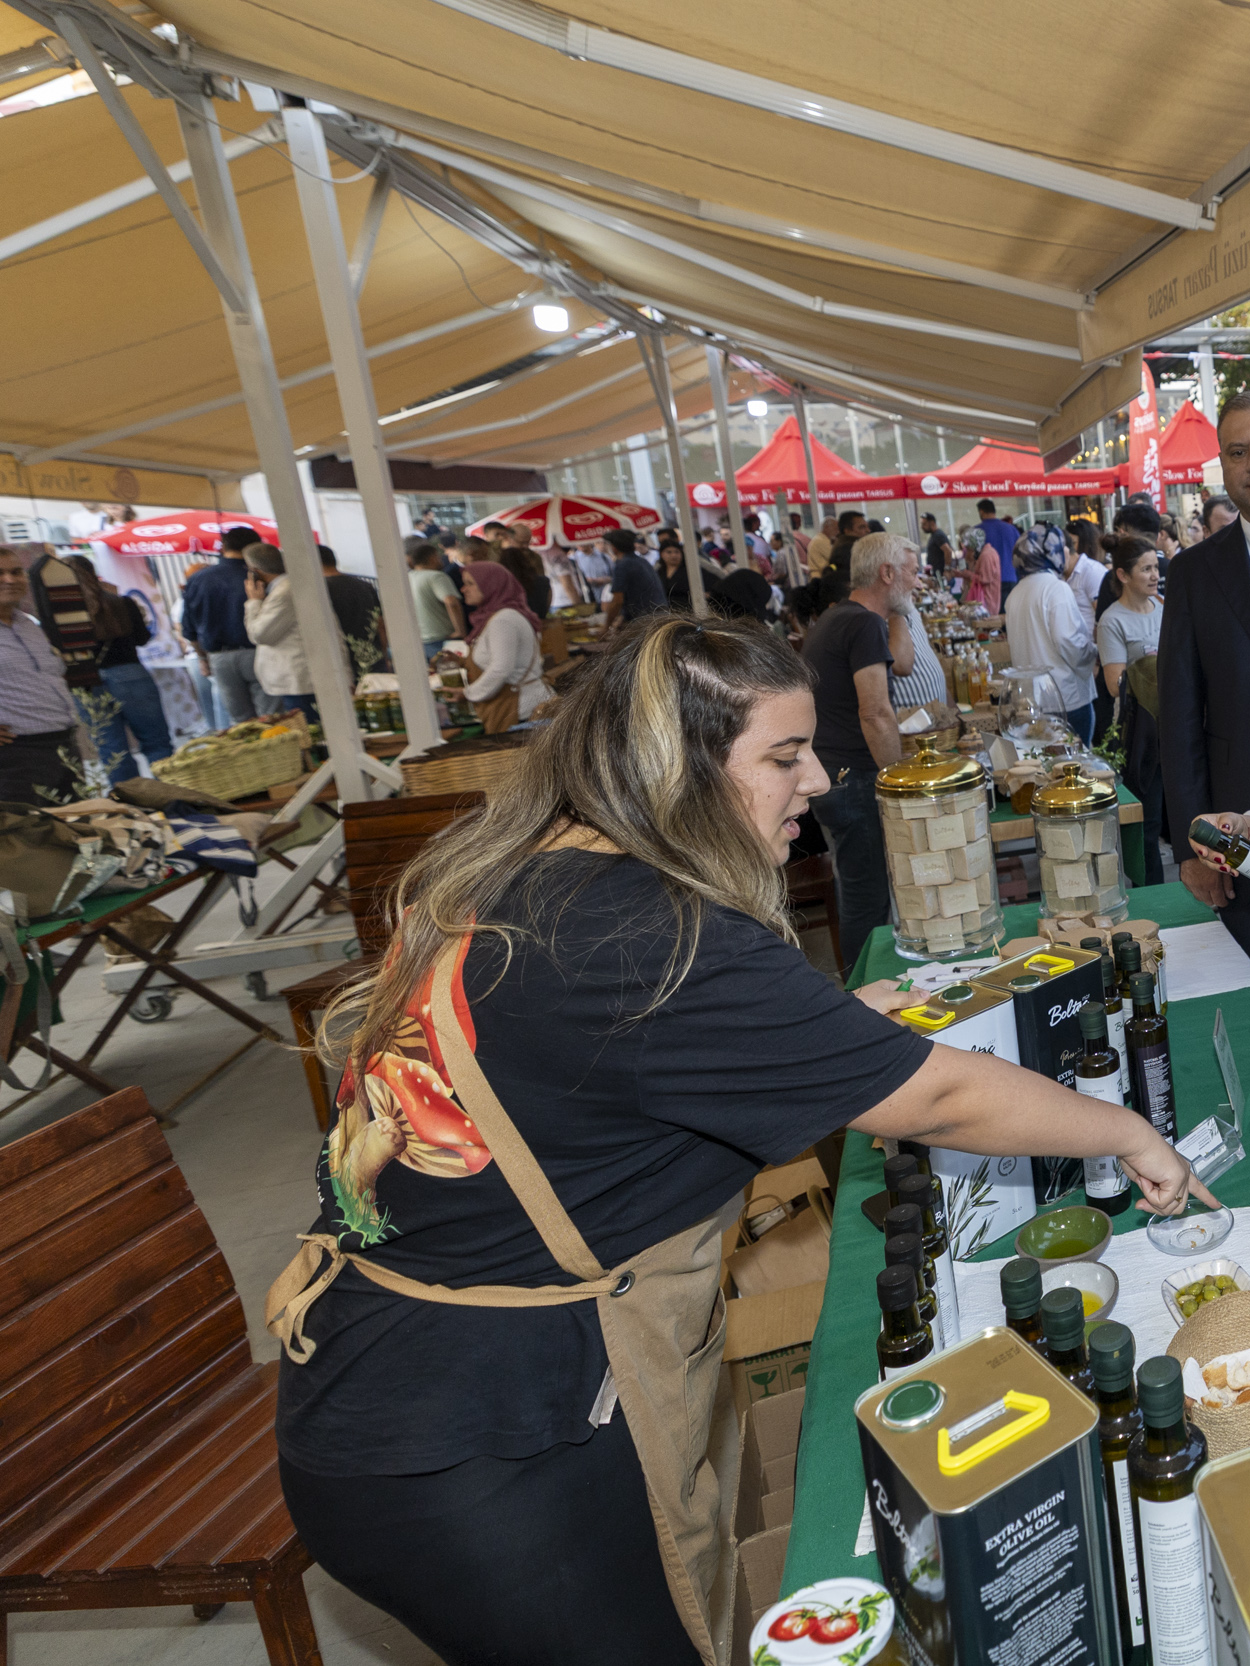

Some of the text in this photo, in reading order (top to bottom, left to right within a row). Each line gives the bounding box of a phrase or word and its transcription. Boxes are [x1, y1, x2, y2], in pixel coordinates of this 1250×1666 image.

[1163, 469, 1186, 480] Slow
[952, 481, 979, 493] Slow
[1013, 482, 1046, 493] Yeryüzü
[1074, 481, 1100, 490] TARSUS
[737, 489, 760, 502] low
[866, 488, 894, 498] TARSUS
[984, 1490, 1066, 1553] EXTRA VIRGIN
[998, 1524, 1034, 1557] OLIVE
[1034, 1511, 1056, 1531] OIL
